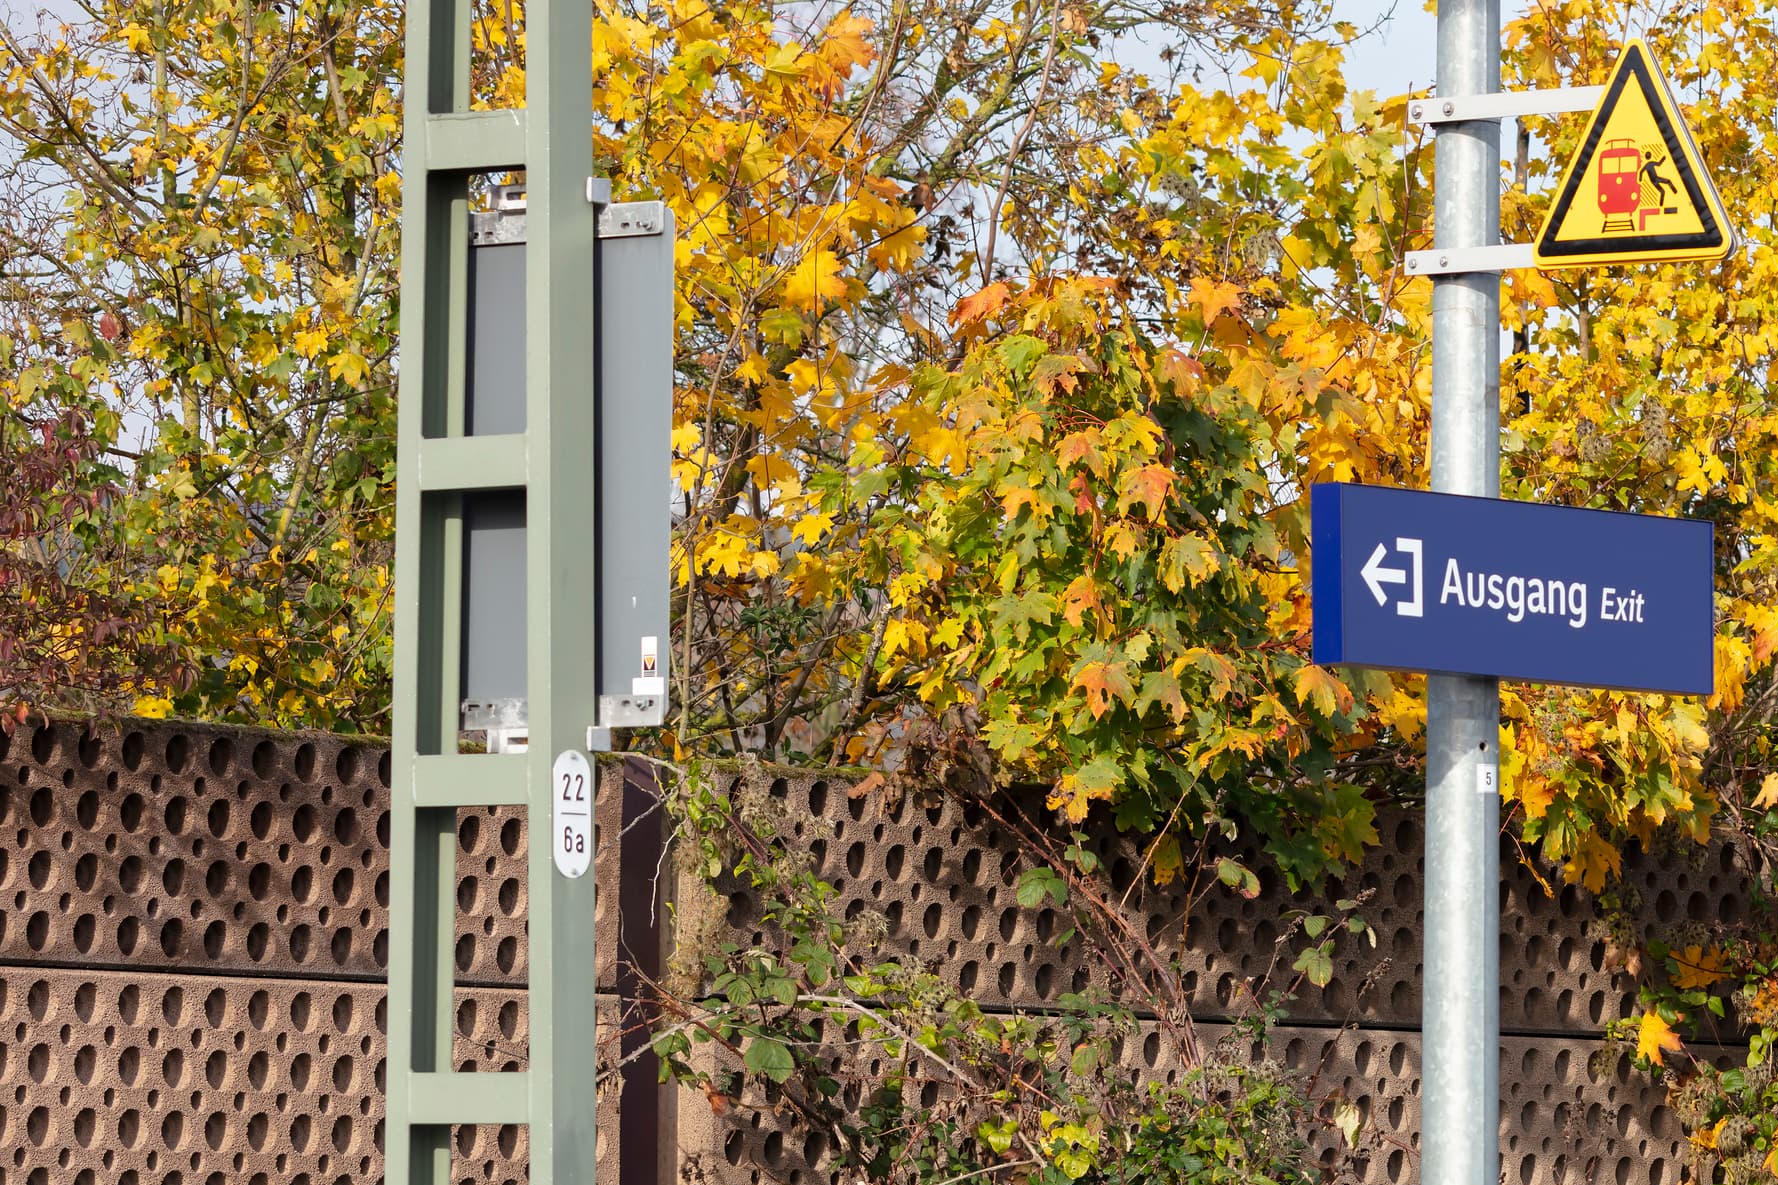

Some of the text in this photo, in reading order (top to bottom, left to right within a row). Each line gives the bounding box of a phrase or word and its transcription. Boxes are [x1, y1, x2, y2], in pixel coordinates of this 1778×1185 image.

[1440, 558, 1645, 628] Ausgang Exit
[563, 773, 584, 801] 22
[564, 826, 584, 853] 6a
